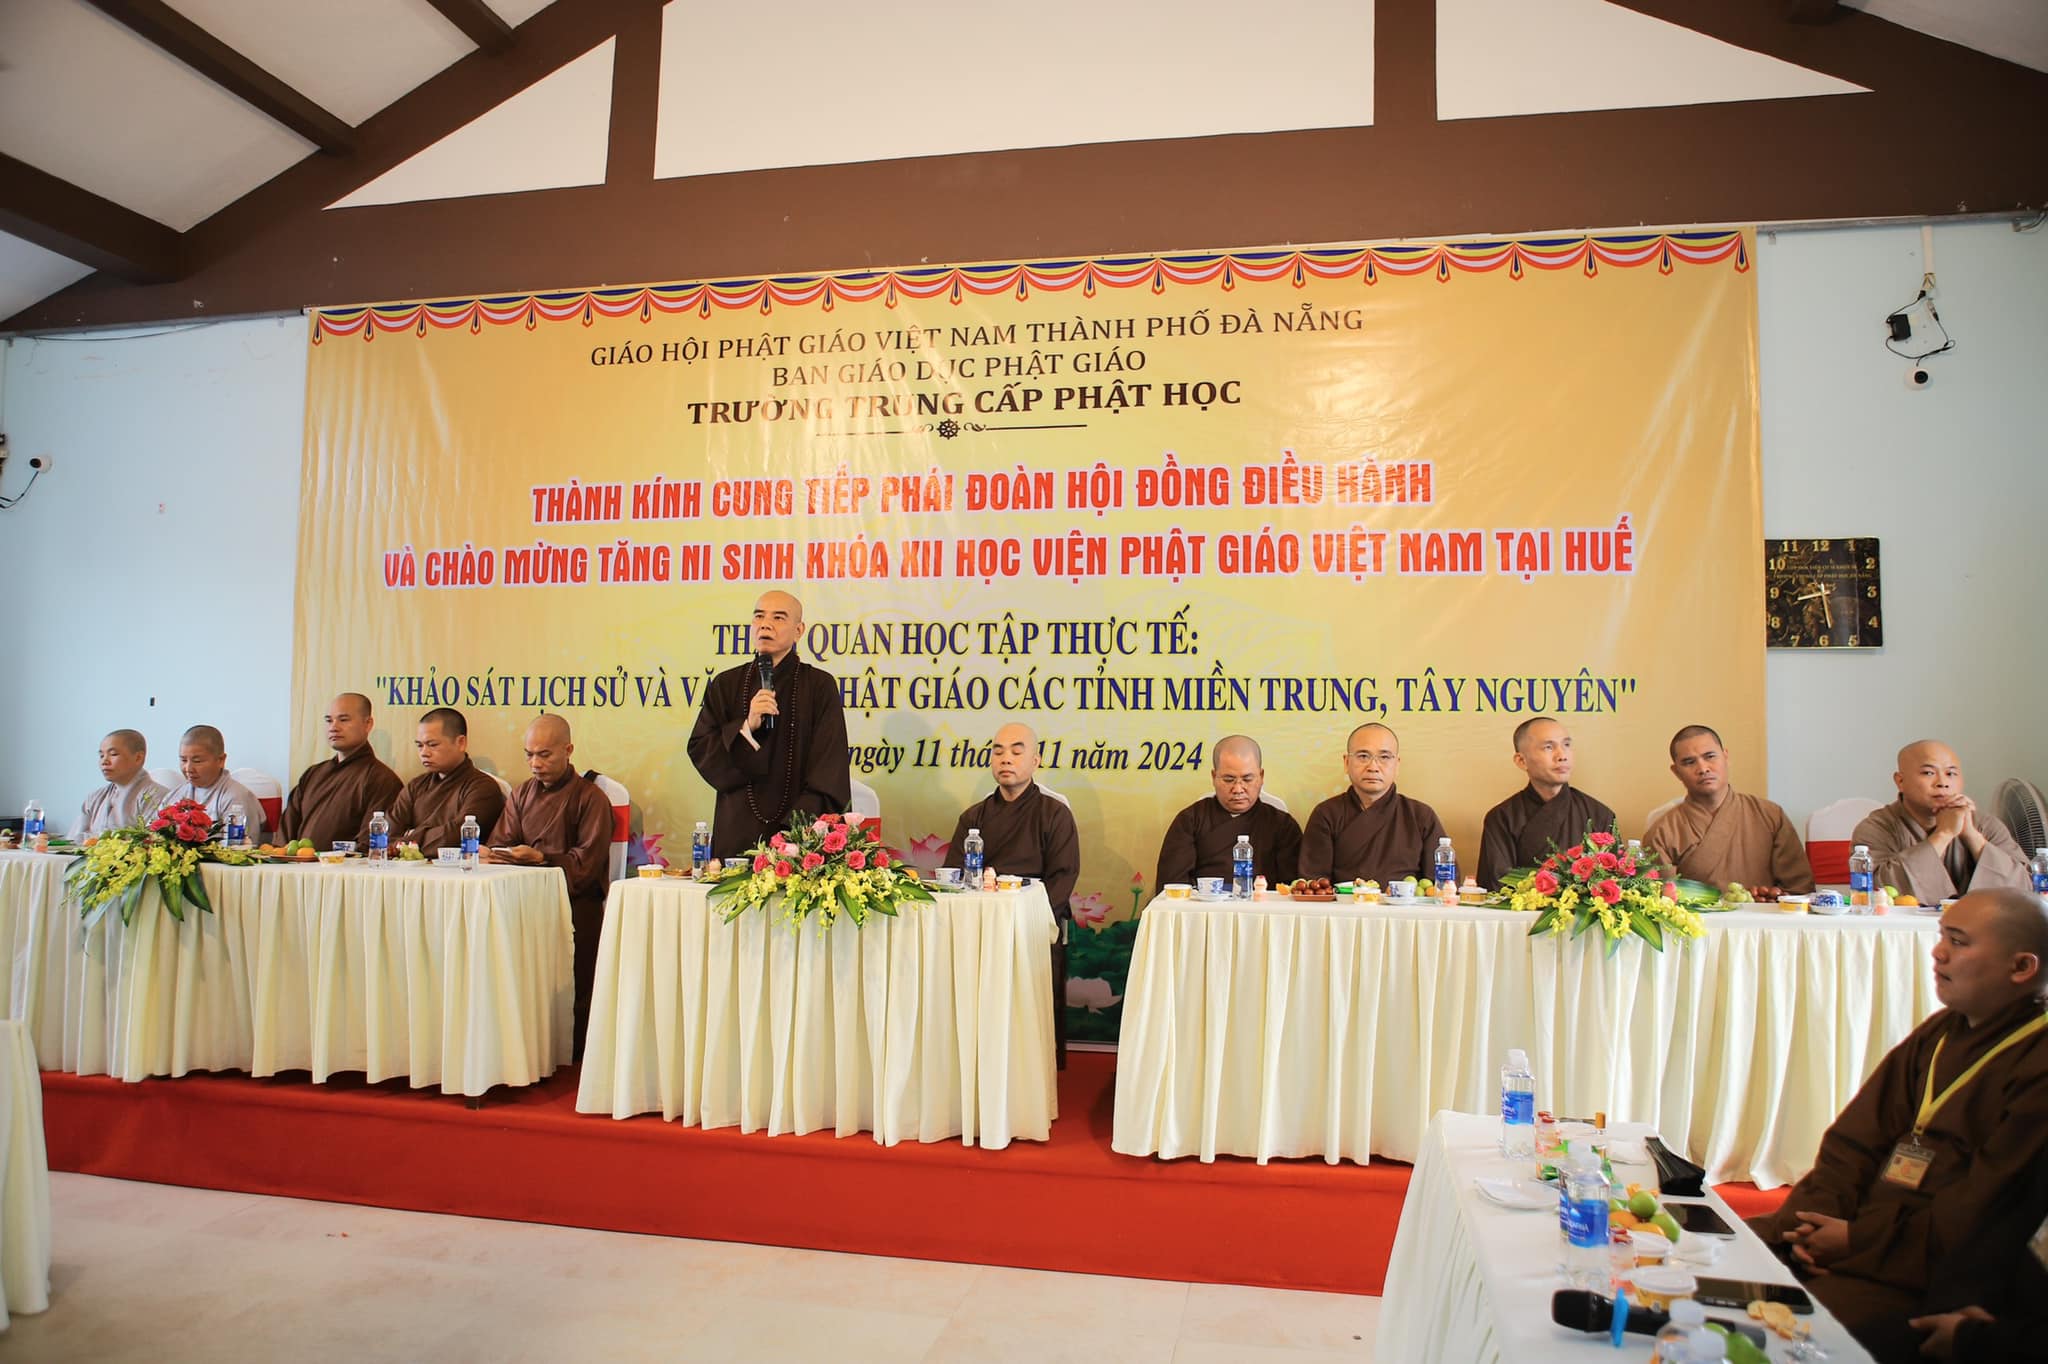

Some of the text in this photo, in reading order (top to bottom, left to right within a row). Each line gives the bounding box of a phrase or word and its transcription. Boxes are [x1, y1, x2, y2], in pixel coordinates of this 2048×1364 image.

[591, 302, 1363, 366] GIÁO HỘI PHẬT GIÁO VIỆT NAM THÀNH PHỐ ĐÀ NẴNG
[772, 346, 1146, 387] BAN GIÁO DỤC PHẬT GIÁO
[687, 379, 1242, 425] TRƯỜNG TRUNG CẤP PHẬT HỌC
[532, 450, 1431, 523] THÀNH KÍNH CUNG TIẾP PHÁI ĐOÀN HỘI ĐỒNG ĐIỀU HÀNH
[384, 515, 1633, 587] VÀ CHÀO MỪNG TĂNG NI SINH KHÓA XII HỌC VIỆN PHẬT GIÁO VIỆT NAM TẠI HUẾ
[1782, 540, 1799, 552] 11
[1812, 540, 1830, 552] 12
[1848, 540, 1856, 552] 1
[1769, 558, 1786, 570] 10
[1865, 557, 1876, 569] 2
[1769, 587, 1779, 599] 9
[1867, 586, 1877, 598] 3
[1770, 616, 1780, 629] 8
[1868, 616, 1878, 628] 4
[713, 604, 1199, 664] TH QUAN HỌC TẬP THỰC TẾ:
[1790, 635, 1800, 647] 7
[1819, 635, 1829, 647] 6
[1848, 635, 1858, 647] 5
[376, 665, 460, 706] "KHẢO
[466, 666, 515, 706] SÁT
[521, 674, 586, 716] LỊCH
[593, 665, 628, 707] SỬ
[637, 666, 672, 707] VÀ
[838, 666, 901, 718] HẬT
[909, 666, 989, 710] GIÁO
[999, 666, 1065, 711] CÁC
[1073, 665, 1153, 711] TỈNH
[1163, 660, 1251, 711] MIỀN
[1260, 678, 1388, 719] TRUNG,
[1396, 667, 1466, 712] TÂY
[1475, 667, 1637, 713] NGUYÊN"
[913, 738, 943, 768] 11
[951, 738, 993, 768] thá
[1071, 738, 1129, 769] năm
[1138, 741, 1203, 771] 2024
